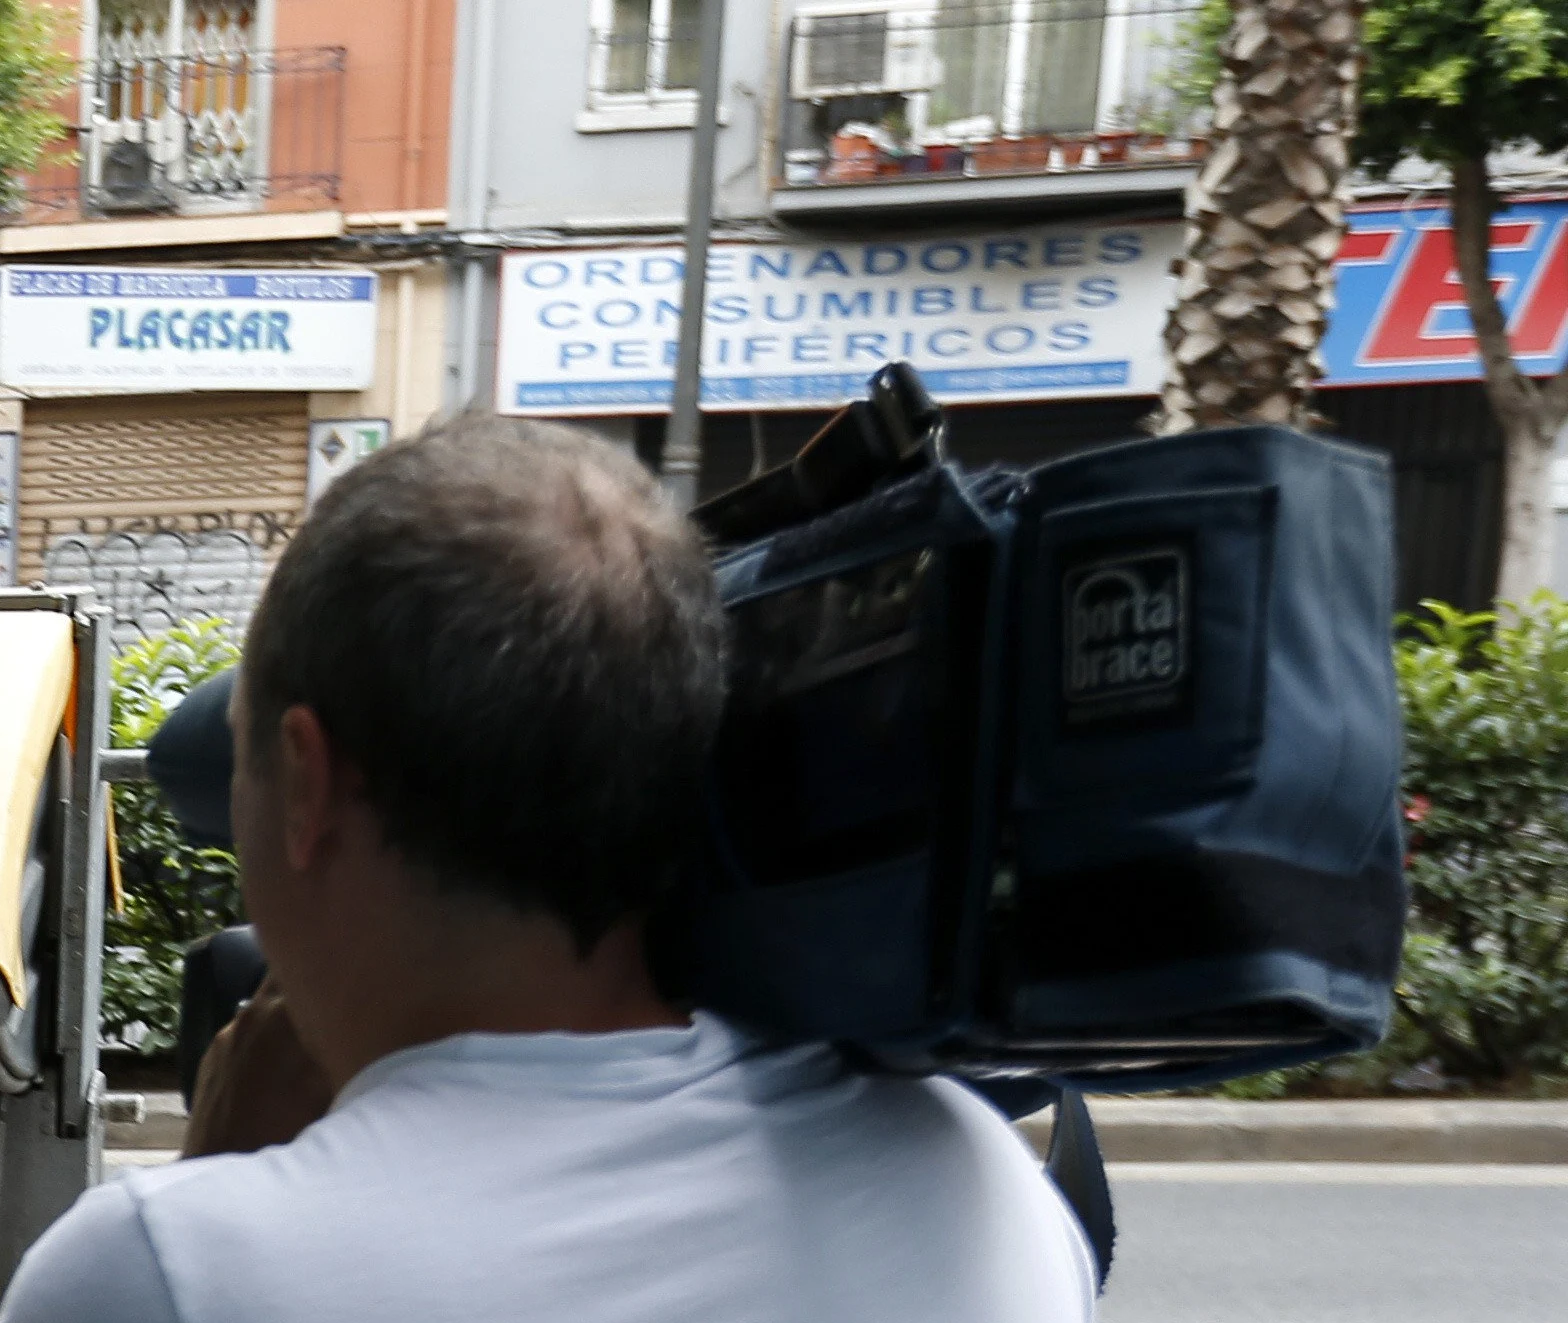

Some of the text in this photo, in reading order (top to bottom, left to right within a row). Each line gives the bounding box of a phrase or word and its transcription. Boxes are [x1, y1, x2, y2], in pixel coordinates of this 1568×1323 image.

[10, 272, 85, 295] PLACAS
[86, 274, 114, 295] DE
[523, 232, 1144, 290] ORDENADORES
[538, 276, 1121, 330] CONSUMIBLES
[89, 307, 292, 352] PLACASAR
[558, 321, 1093, 370] PEIFÉRICOS
